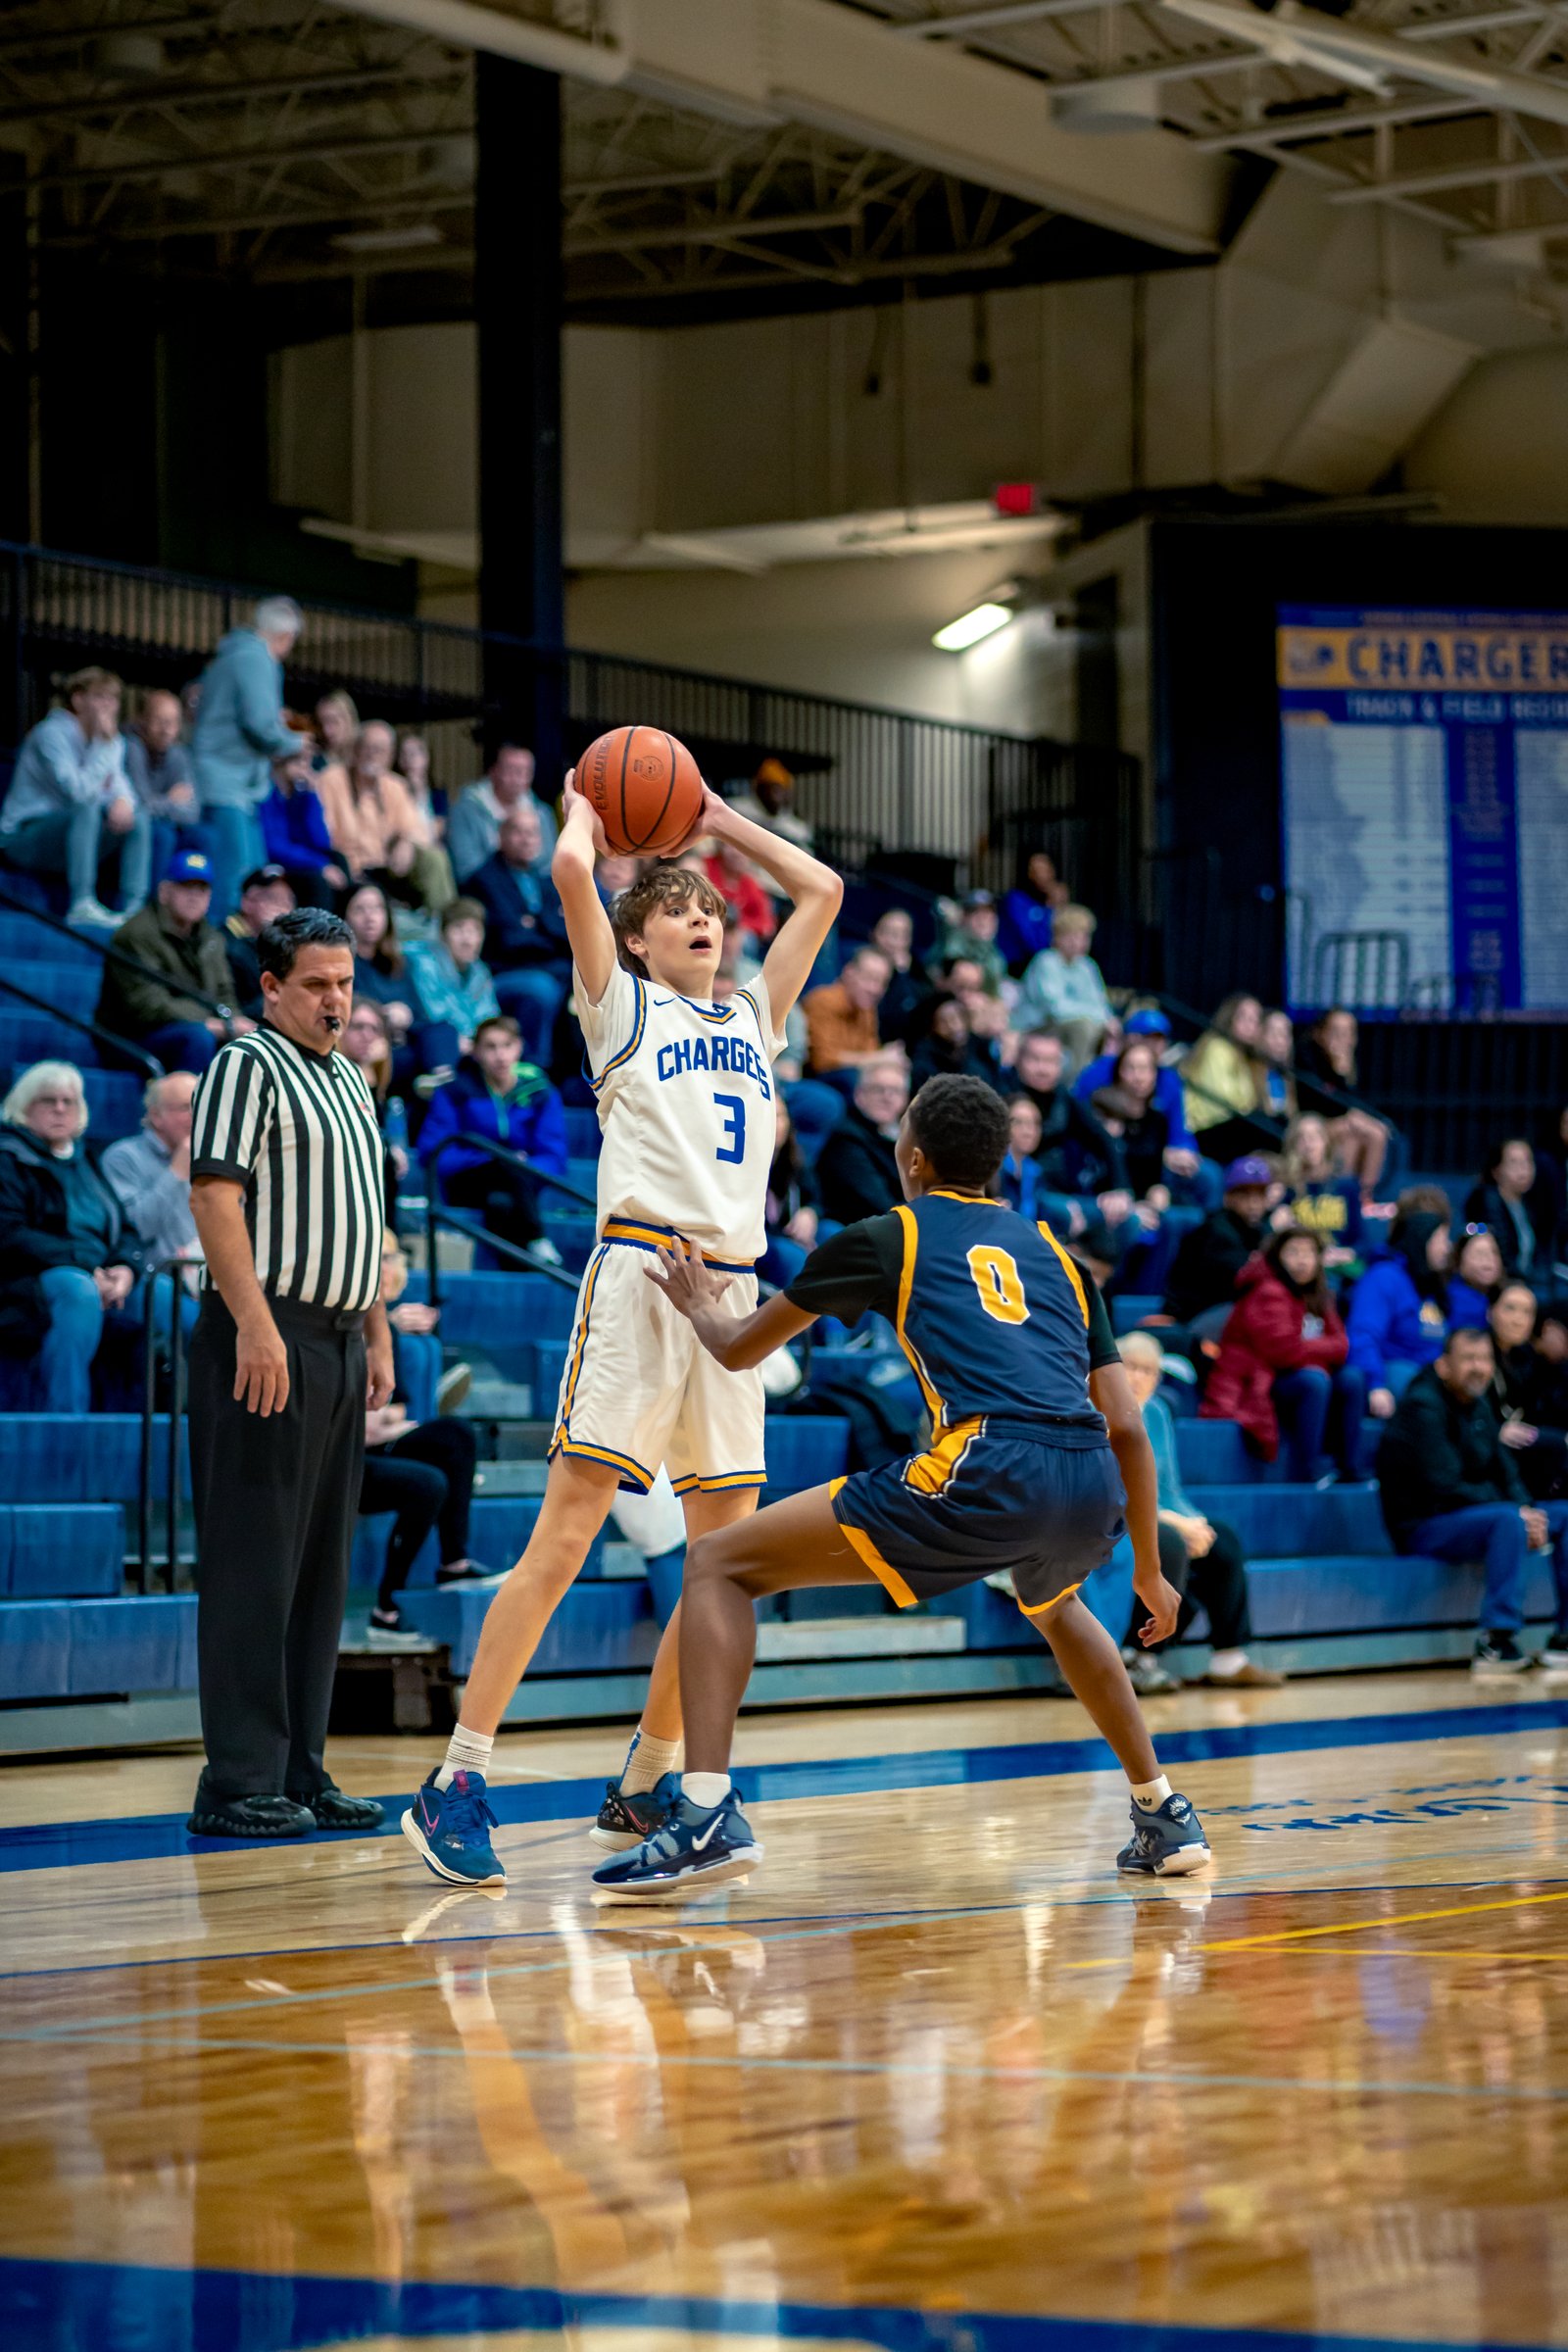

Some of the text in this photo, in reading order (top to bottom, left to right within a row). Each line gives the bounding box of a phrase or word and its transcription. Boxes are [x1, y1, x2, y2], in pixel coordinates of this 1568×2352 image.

[657, 1036, 771, 1102] CHARGES
[713, 1093, 746, 1164] 3
[966, 1245, 1030, 1325] 0
